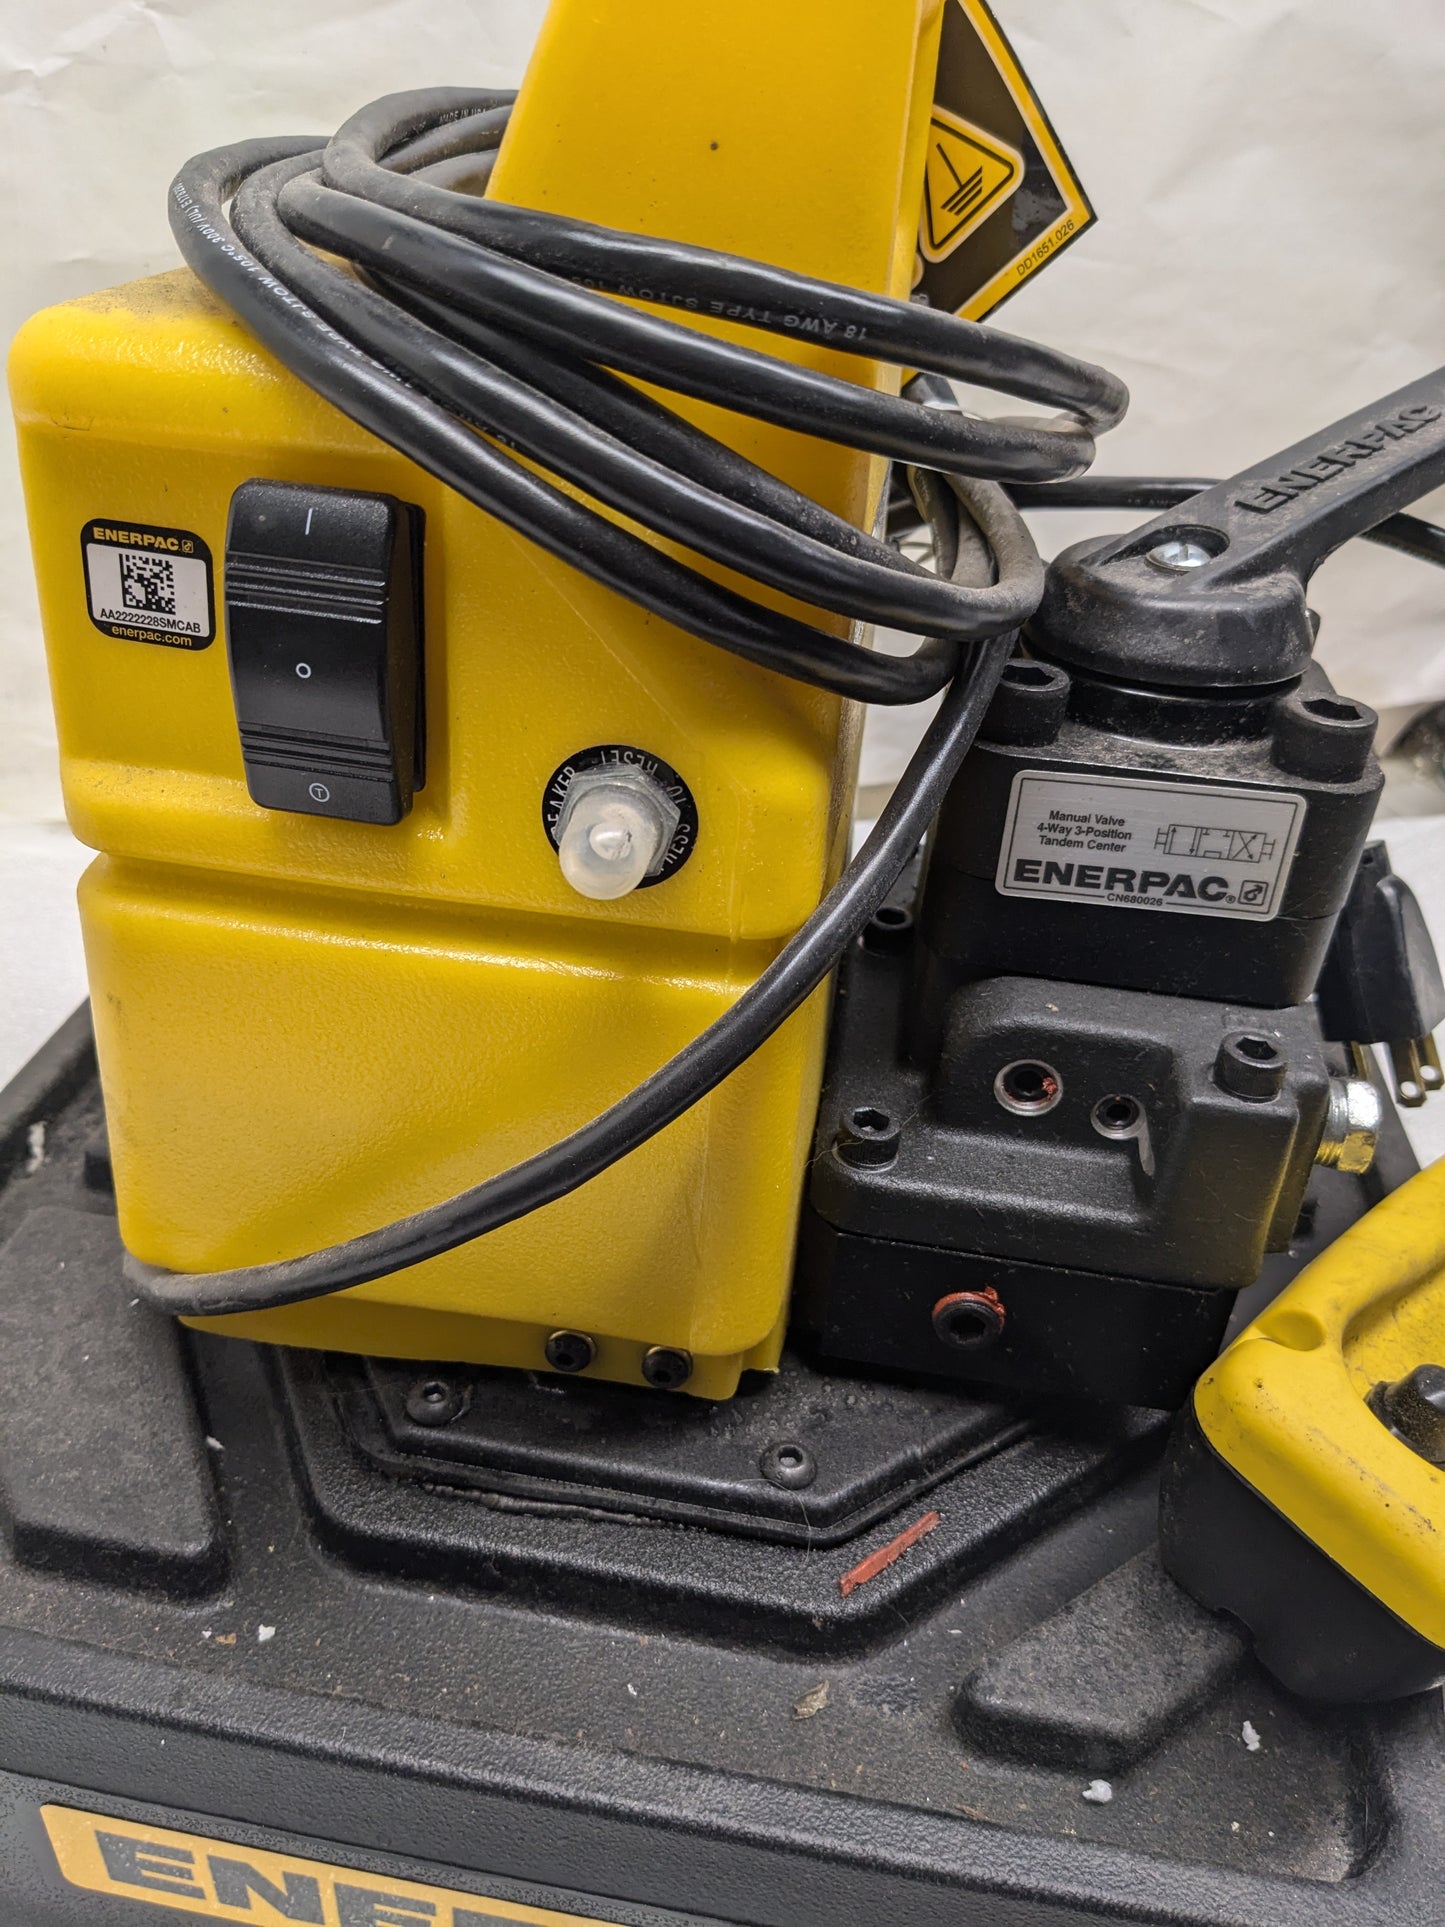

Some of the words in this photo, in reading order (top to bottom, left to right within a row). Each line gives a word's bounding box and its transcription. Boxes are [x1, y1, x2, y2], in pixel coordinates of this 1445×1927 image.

[1016, 219, 1075, 276] DD1651.026
[617, 284, 699, 309] SJTOW
[709, 300, 772, 324] TYPE
[783, 314, 839, 335] AWG
[843, 324, 867, 341] 18
[1233, 405, 1443, 515] ENERPAC
[92, 526, 180, 552] ENERPAC
[100, 607, 202, 634] AA2222228SMCAB
[111, 625, 193, 647] enerpac.com
[1048, 809, 1092, 825] Manual
[1094, 813, 1126, 827] Valve
[1036, 822, 1073, 837] 4-Way
[1074, 825, 1133, 841] 3-Position
[1038, 834, 1084, 849] Tandem
[1086, 839, 1127, 853] Center
[1106, 892, 1164, 907] CN680026
